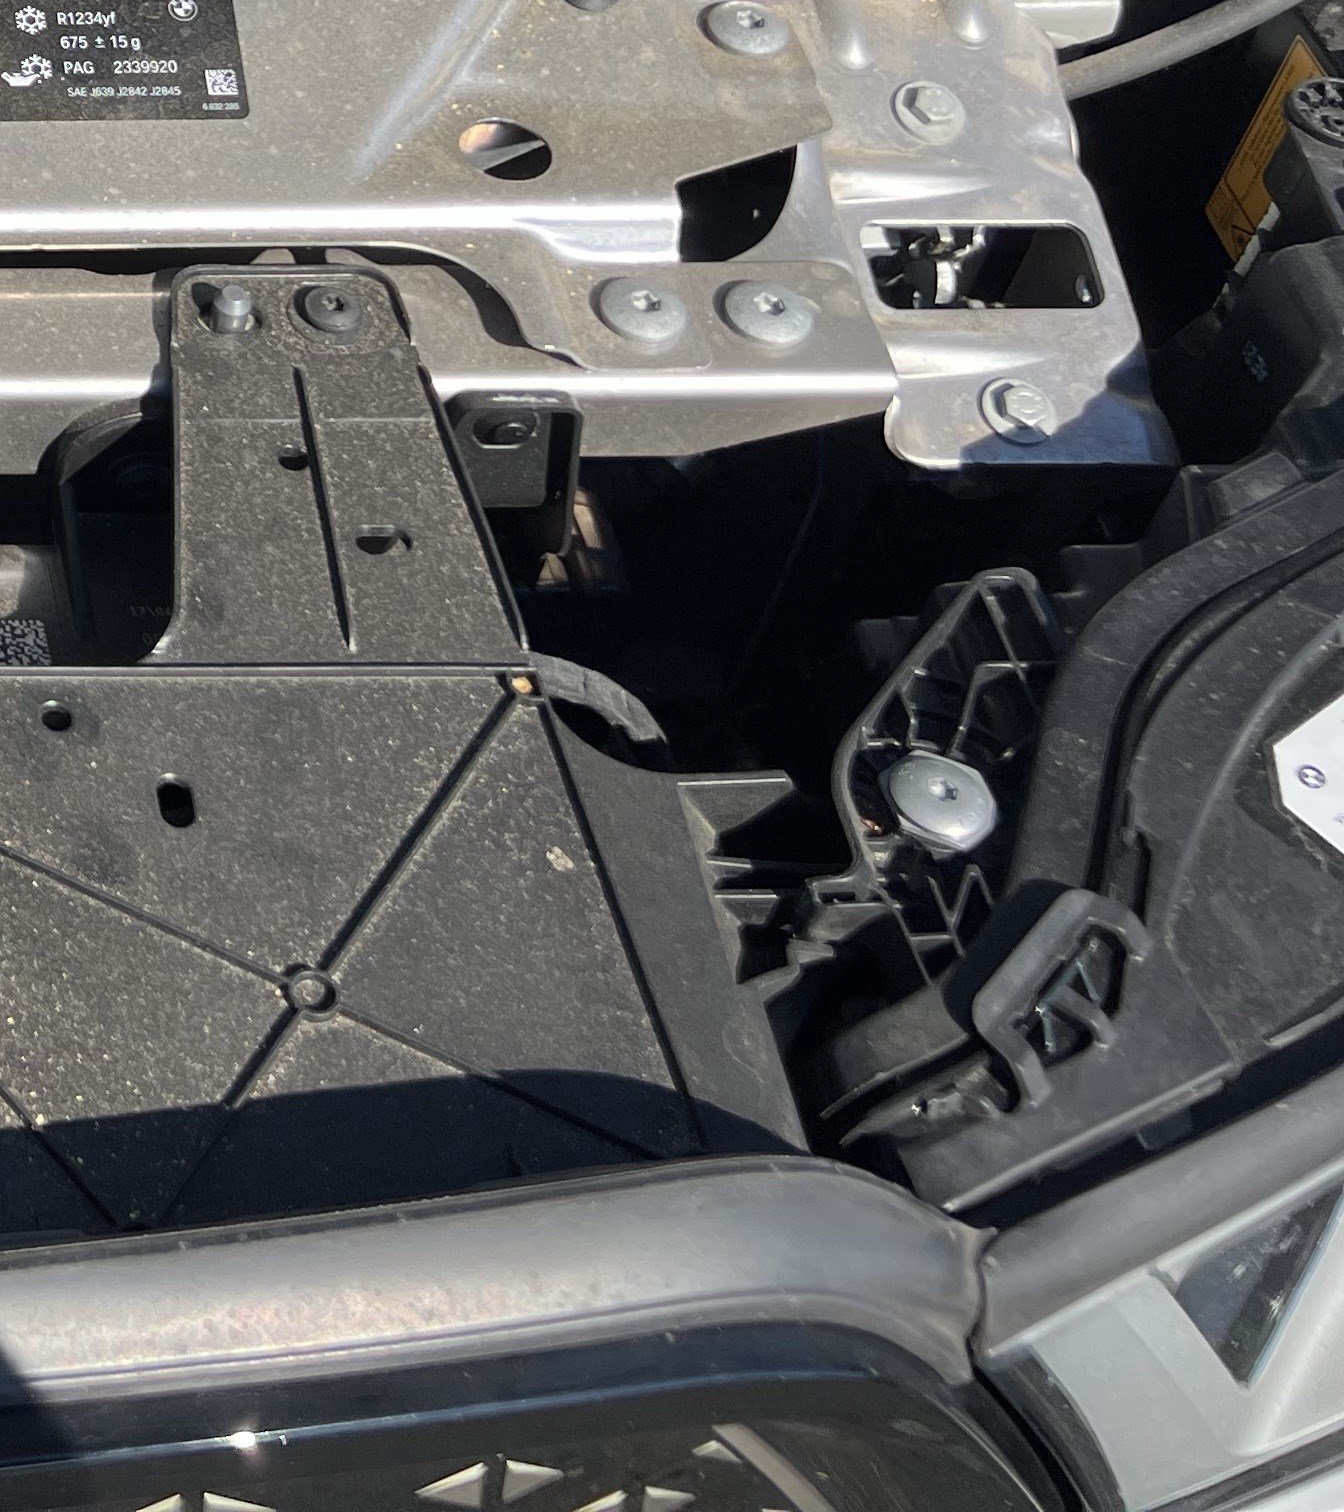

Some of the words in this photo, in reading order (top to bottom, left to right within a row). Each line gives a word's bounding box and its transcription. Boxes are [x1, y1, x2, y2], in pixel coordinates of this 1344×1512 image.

[56, 11, 117, 26] R1234yf
[60, 35, 88, 50] 675
[109, 35, 129, 49] 15
[130, 37, 141, 51] g
[63, 61, 95, 75] PAG
[113, 60, 178, 75] 2339920
[66, 86, 88, 97] SAE
